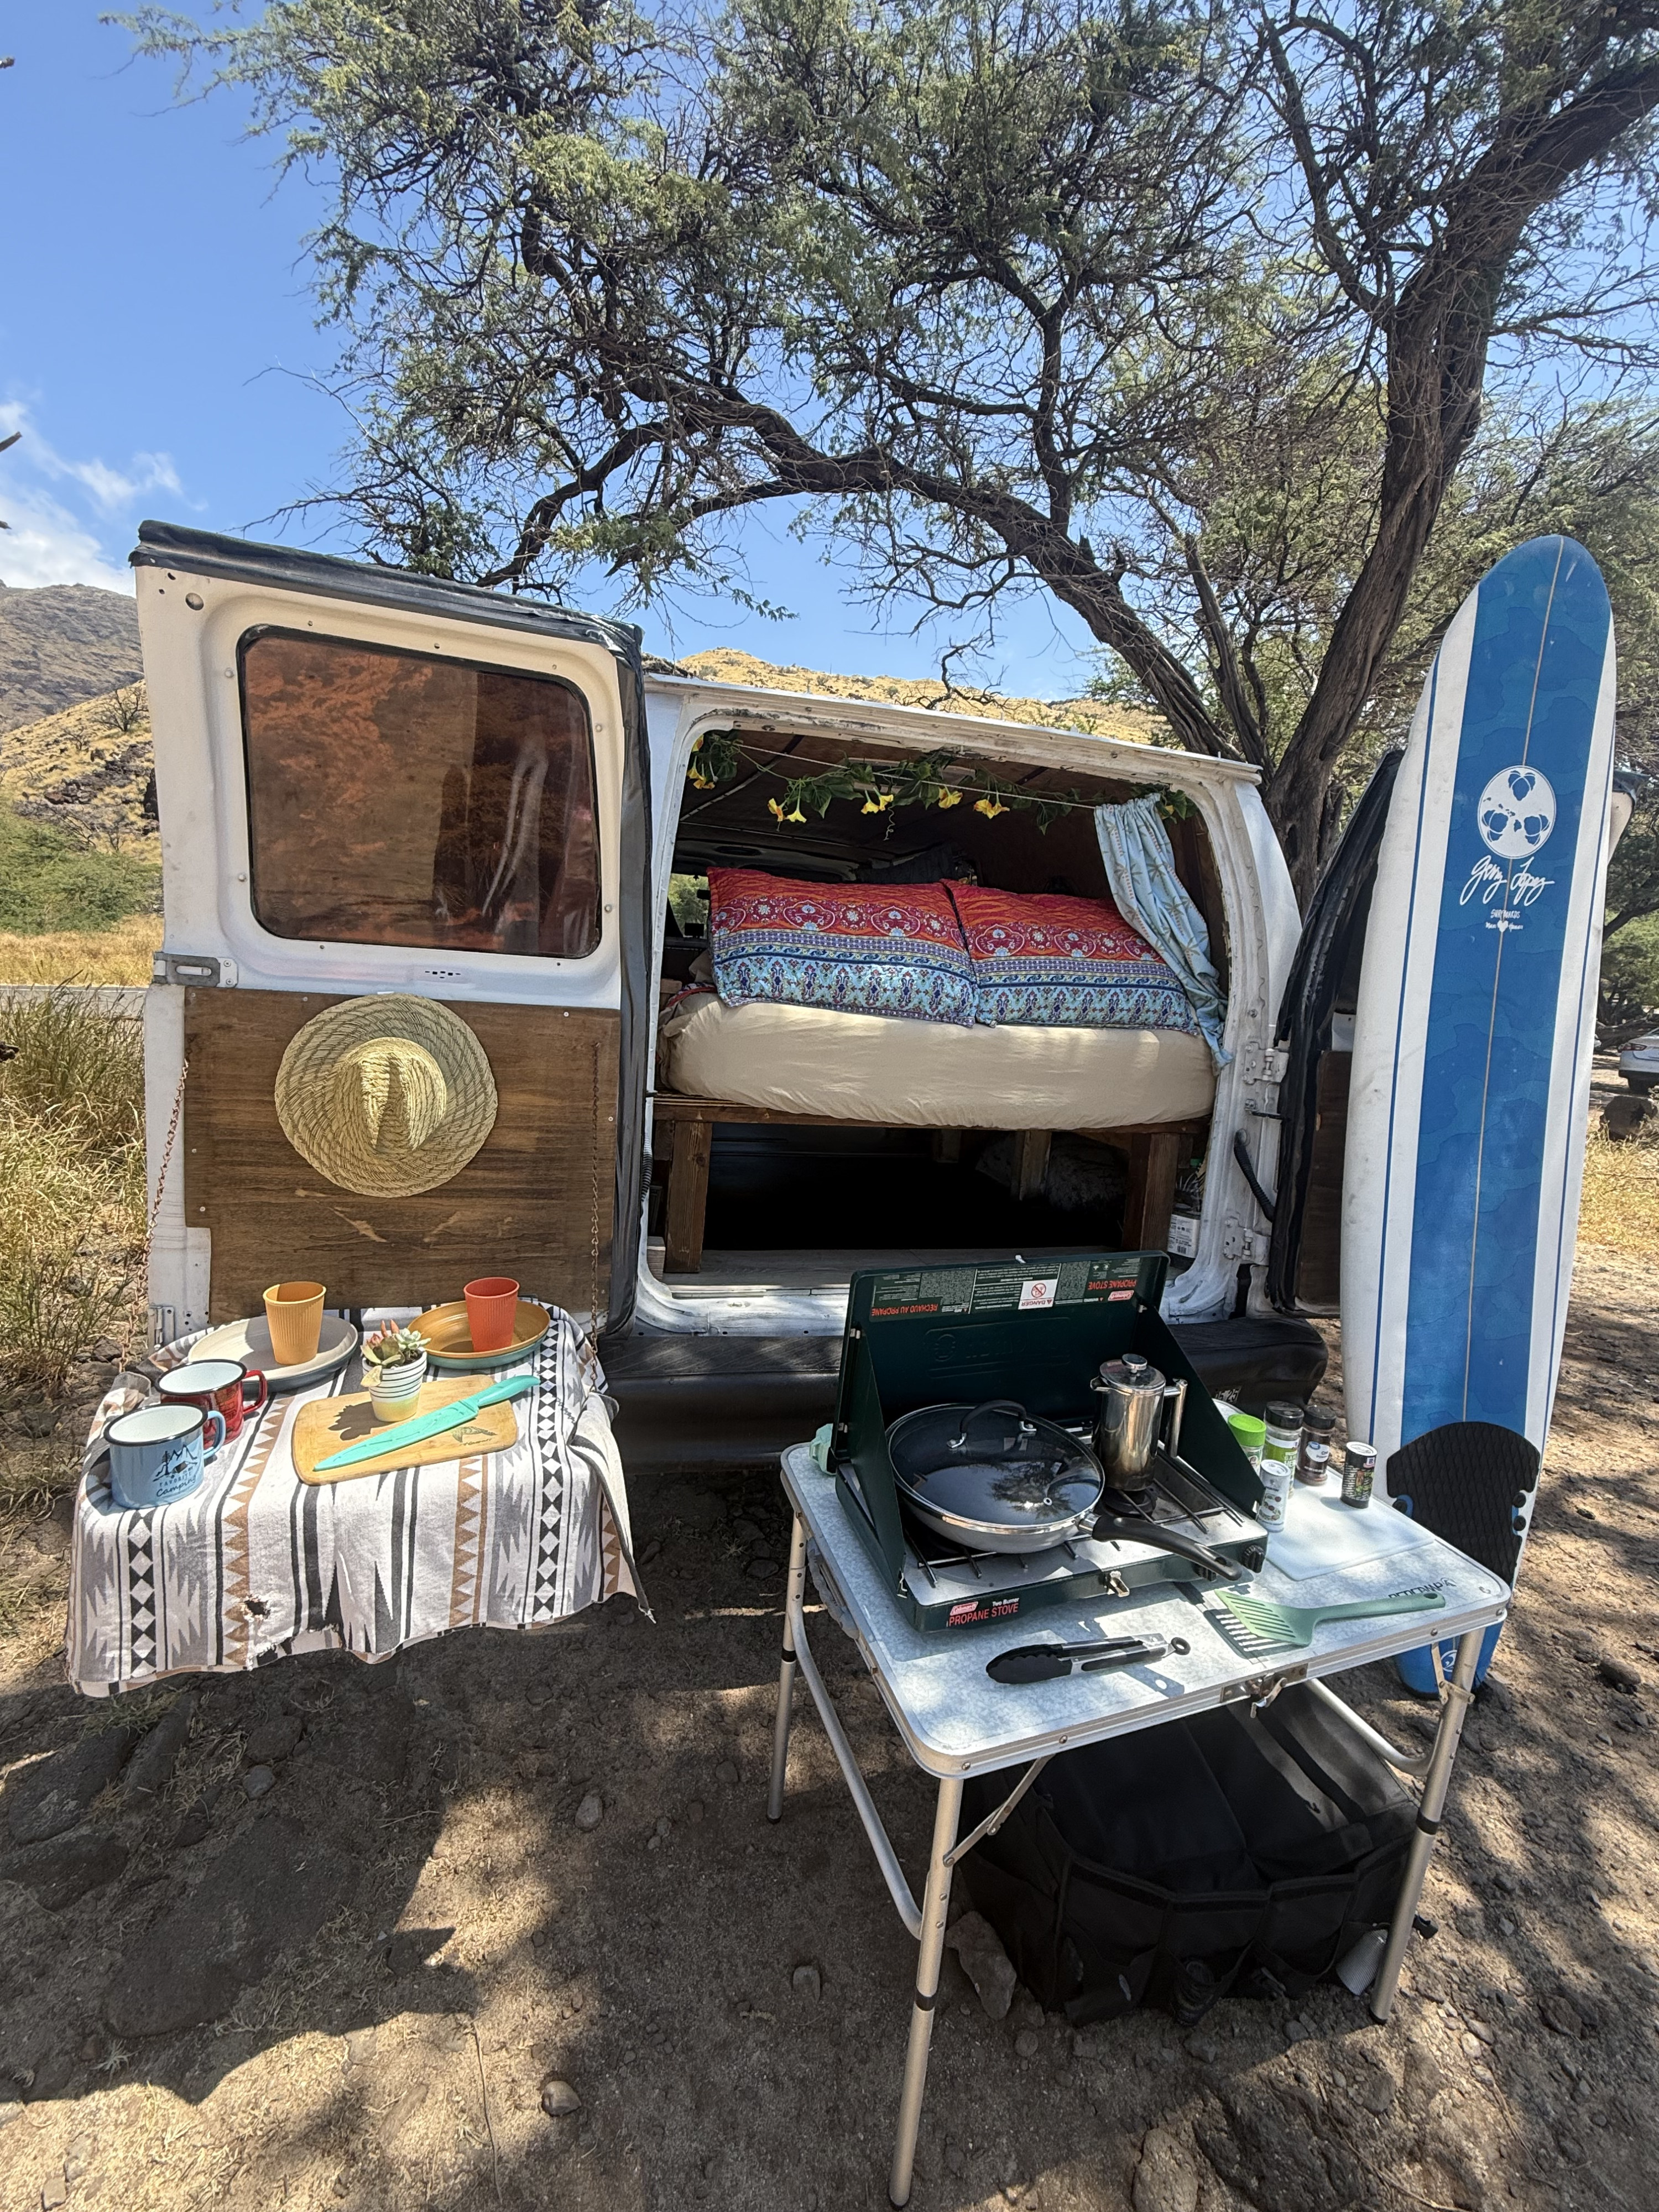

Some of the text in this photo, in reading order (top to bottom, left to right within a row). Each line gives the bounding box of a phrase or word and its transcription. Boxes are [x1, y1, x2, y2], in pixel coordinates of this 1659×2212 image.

[1088, 1279, 1137, 1290] PROPANE STOVE
[871, 1307, 899, 1316] PROPANE
[156, 1475, 196, 1497] Camping
[949, 1603, 1019, 1626] PROPANE STOVE
